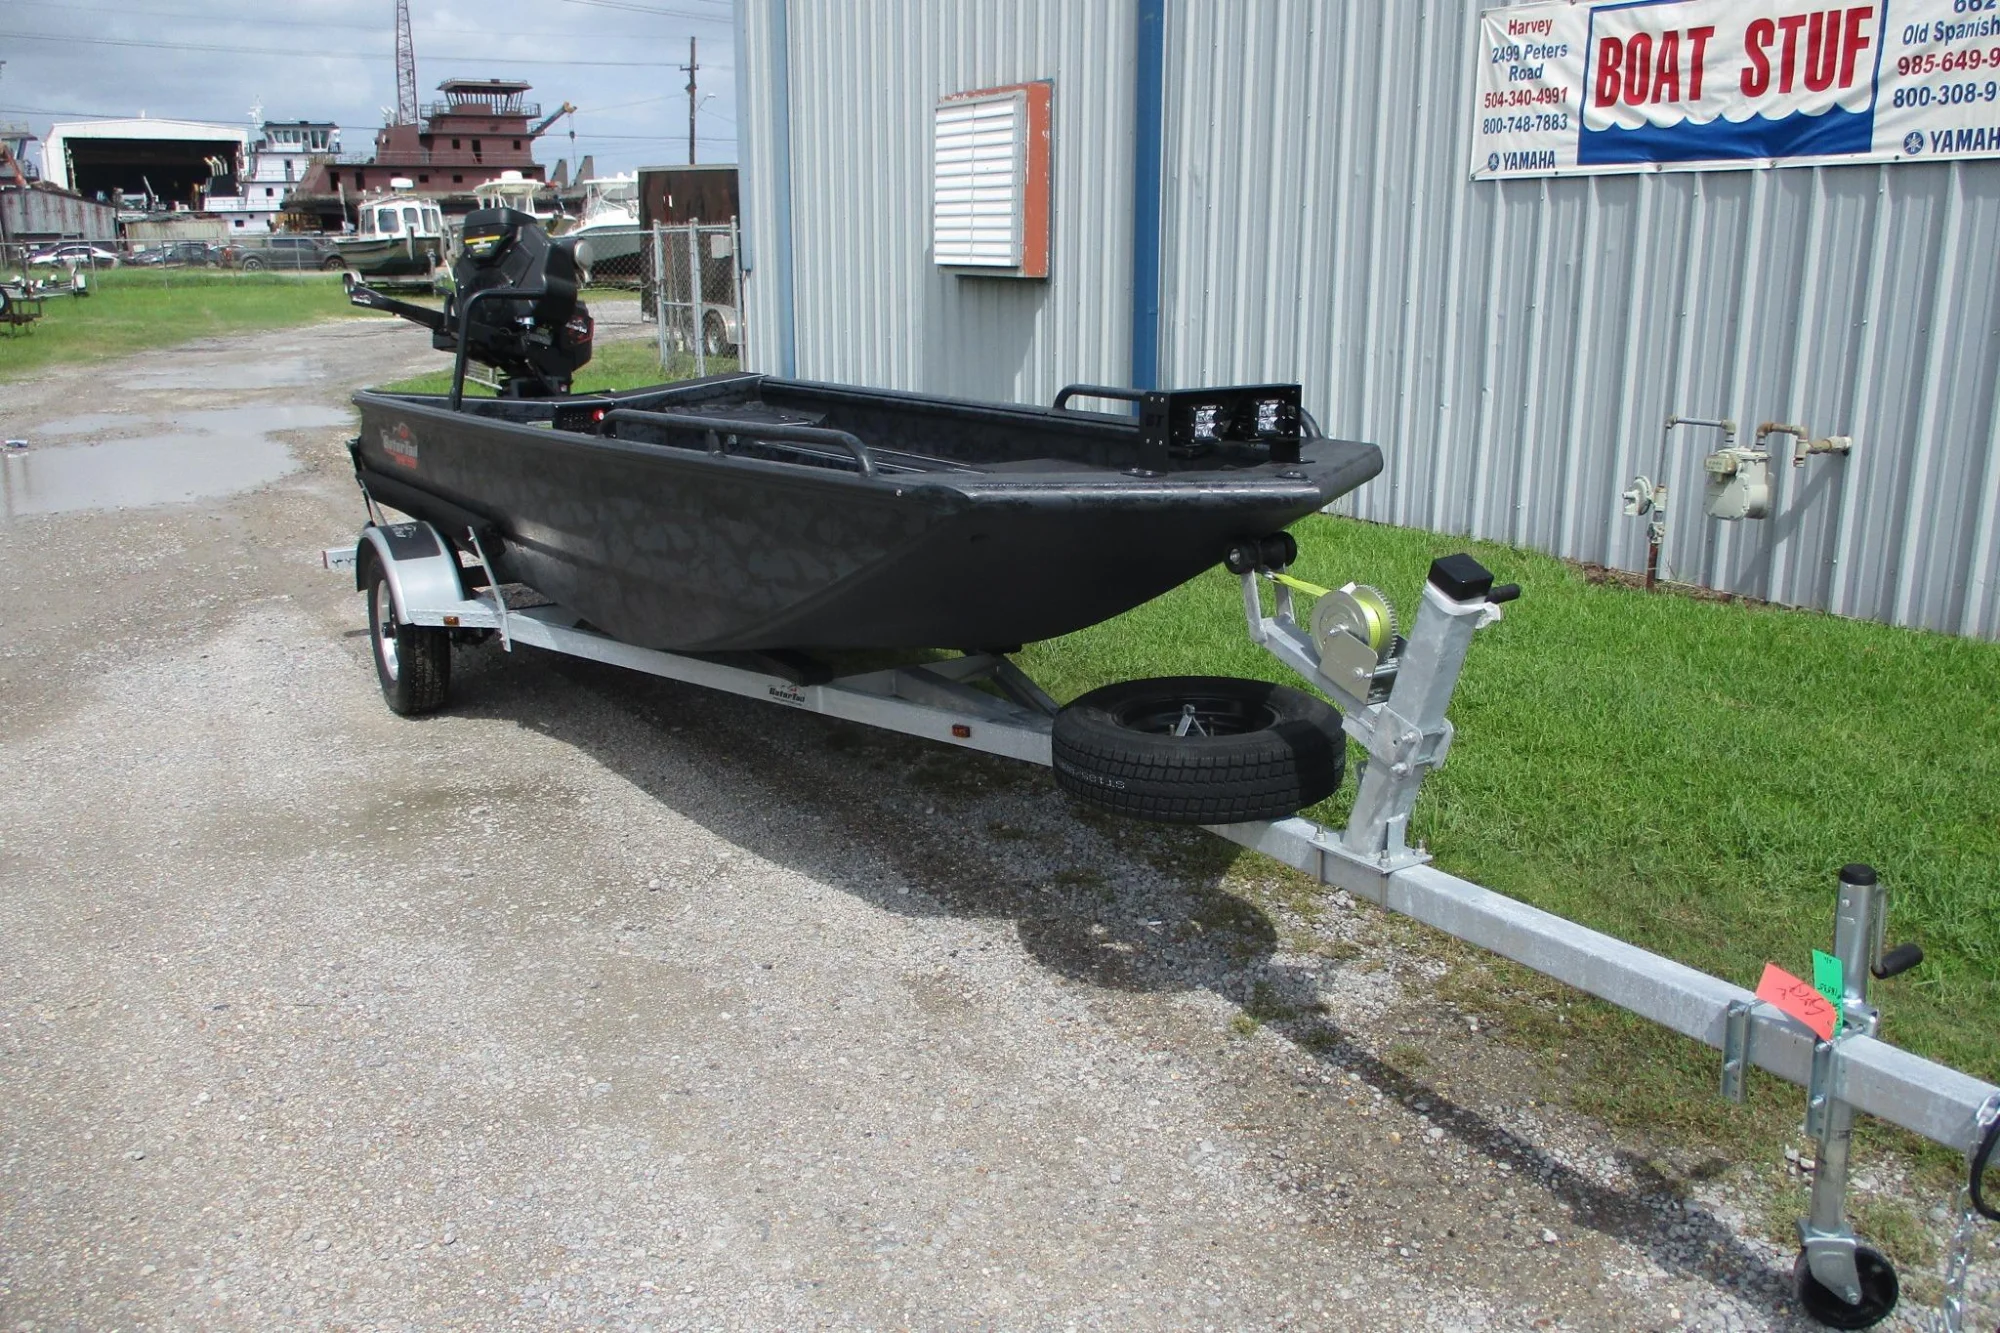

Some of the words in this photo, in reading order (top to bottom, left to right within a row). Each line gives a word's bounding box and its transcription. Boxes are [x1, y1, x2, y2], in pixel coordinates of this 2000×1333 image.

[1508, 19, 1553, 37] Harvey
[1903, 22, 1929, 45] Old
[1933, 15, 2000, 46] Spanish
[1492, 45, 1520, 64] 2499
[1523, 43, 1568, 60] Peters
[1595, 25, 1715, 108] BOAT
[1740, 6, 1873, 98] STUF
[1897, 47, 2000, 76] 985-649-9
[1508, 63, 1544, 82] Road
[1484, 87, 1568, 108] 504-340-4991
[1893, 81, 2000, 108] 800-308-9
[1483, 113, 1568, 134] 800-748-7883
[1503, 150, 1556, 171] YAMAHA
